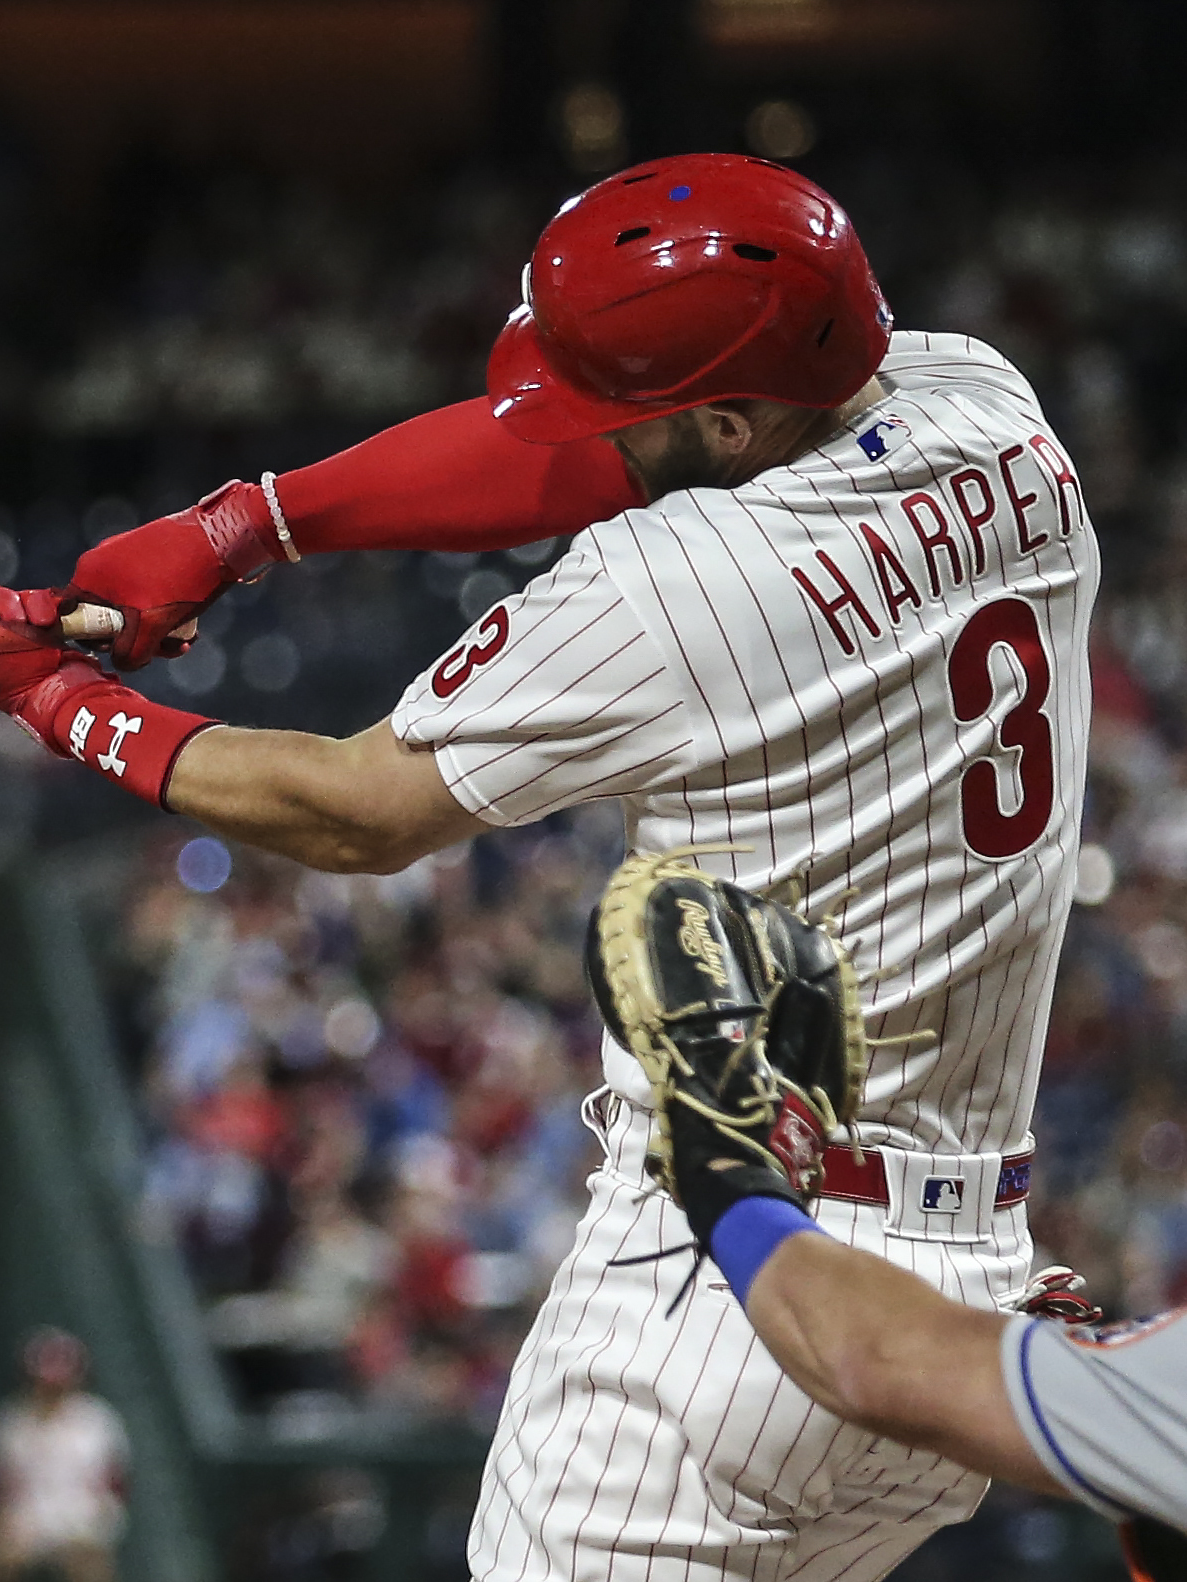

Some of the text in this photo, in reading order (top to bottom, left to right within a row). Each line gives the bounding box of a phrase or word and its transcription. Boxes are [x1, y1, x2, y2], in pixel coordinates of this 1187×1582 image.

[431, 603, 511, 700] 3
[790, 433, 1084, 656] HARPER
[947, 595, 1055, 861] 3
